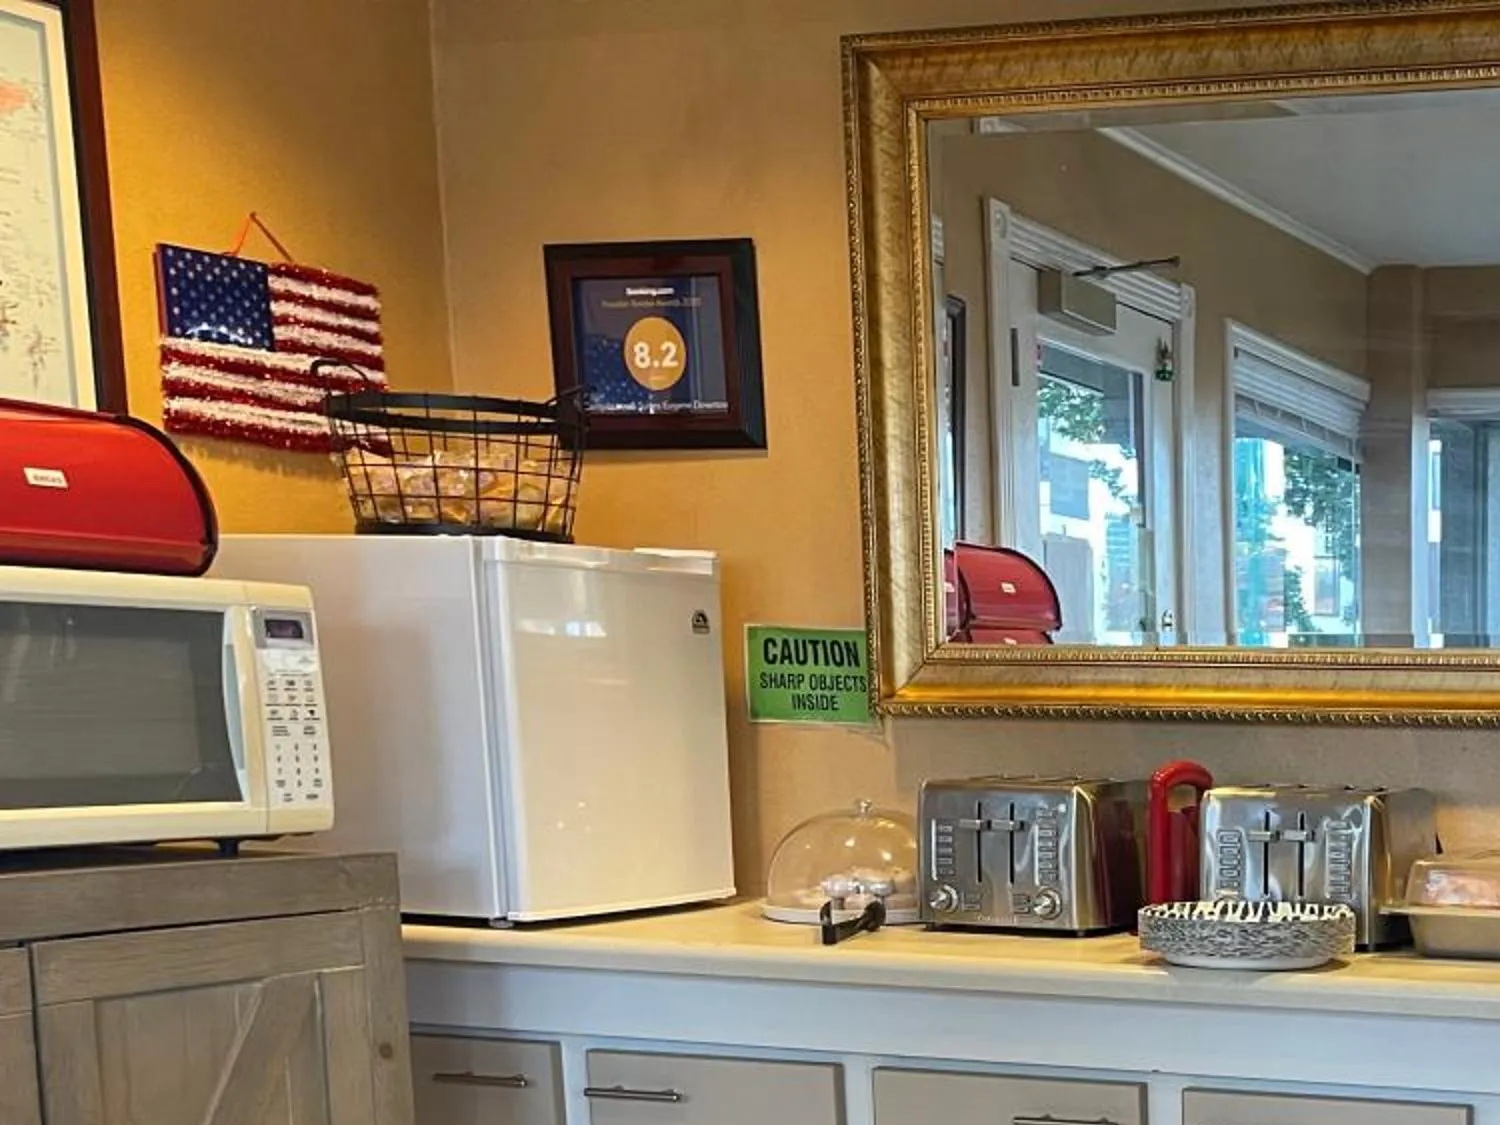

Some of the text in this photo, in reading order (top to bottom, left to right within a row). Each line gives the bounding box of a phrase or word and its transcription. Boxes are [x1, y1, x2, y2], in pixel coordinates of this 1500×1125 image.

[633, 341, 679, 368] 8.2
[763, 637, 861, 668] CAUTION
[760, 671, 867, 693] SHARP OBJECTS
[791, 693, 841, 711] INSIDE
